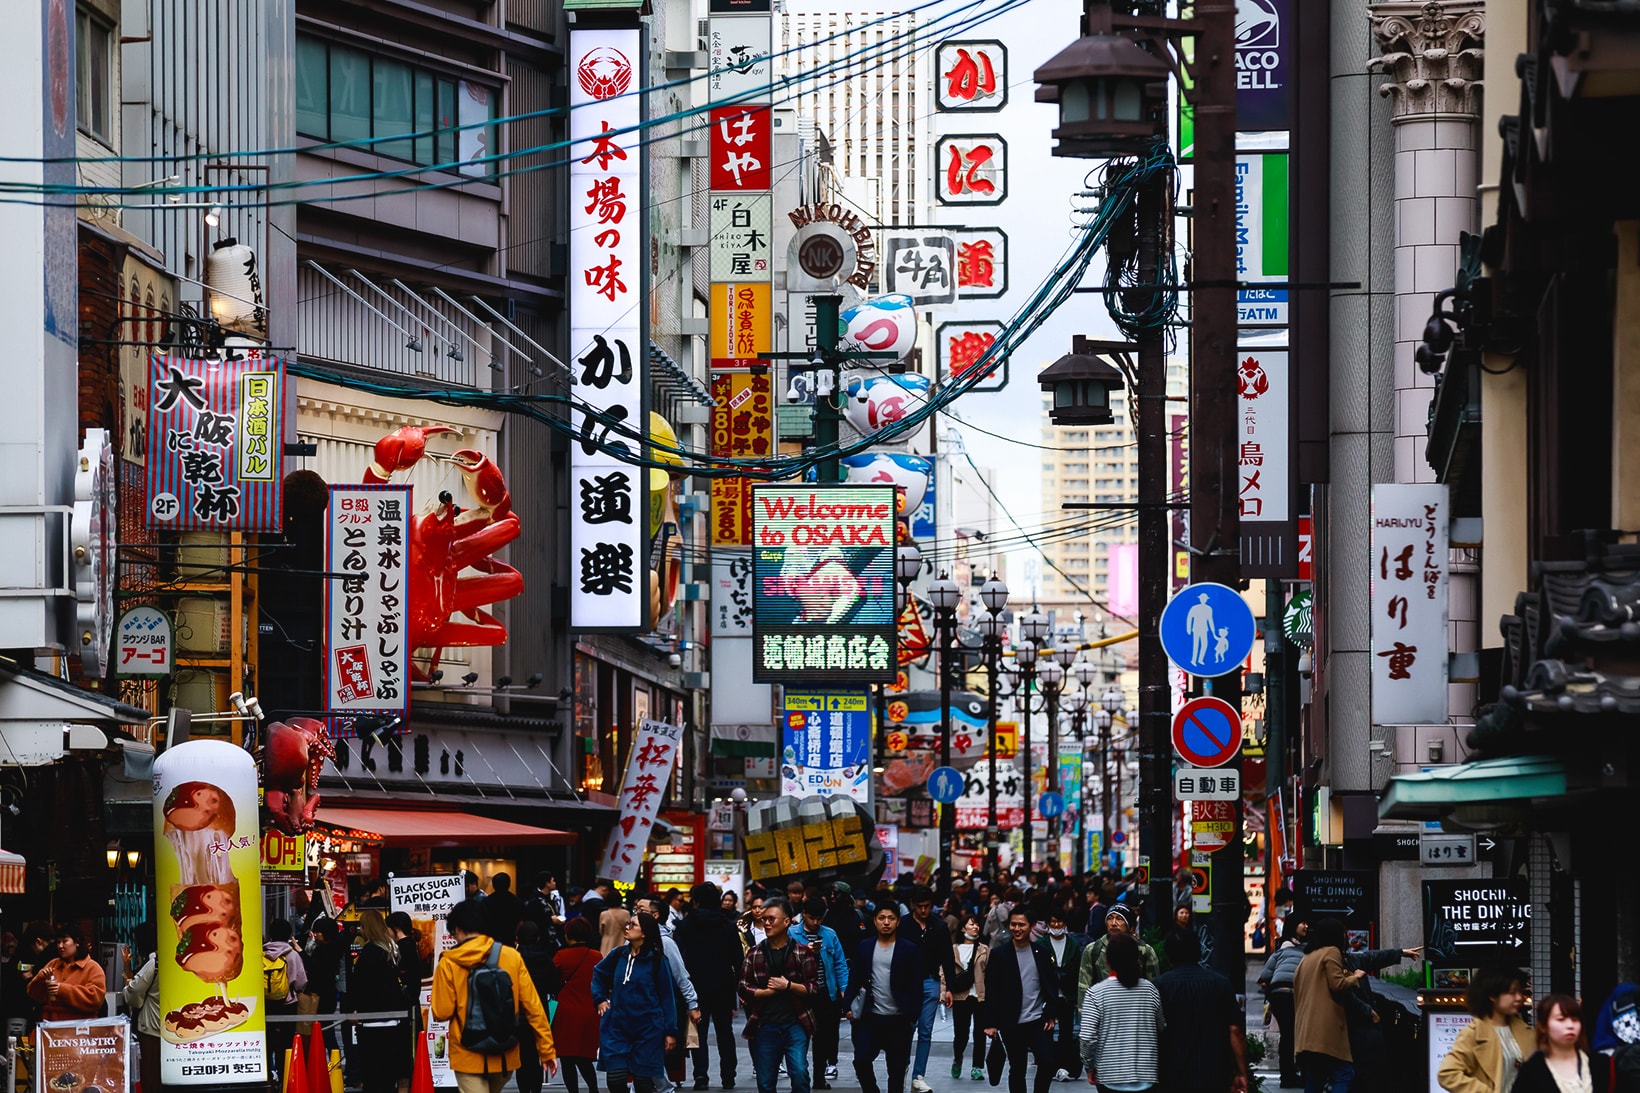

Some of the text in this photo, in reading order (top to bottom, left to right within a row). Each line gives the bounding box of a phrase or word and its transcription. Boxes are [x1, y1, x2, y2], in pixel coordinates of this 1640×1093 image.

[1234, 51, 1279, 70] ACO
[1236, 71, 1279, 90] ELL
[719, 110, 761, 185] はや
[581, 120, 628, 302] 本場の味
[713, 199, 728, 211] 4F
[788, 202, 858, 231] NIKOH
[730, 202, 767, 275] 白木屋
[809, 247, 833, 267] NK
[246, 378, 268, 474] 日本酒バル
[1245, 407, 1257, 434] 三代目
[155, 365, 240, 522] 大阪に乾杯
[155, 499, 177, 515] 2F
[341, 498, 368, 512] B級
[759, 493, 889, 520] Welcome
[338, 513, 372, 524] グルメ
[1376, 518, 1423, 528] HARIJYU
[760, 524, 890, 546] to OSAKA
[376, 500, 402, 701] 温泉水しゃぶしゃぶ
[1376, 544, 1418, 680] はり重
[122, 635, 165, 644] ラウンジ BAR
[122, 647, 166, 664] アーゴ
[787, 697, 807, 705] 340m
[808, 775, 842, 787] EDION
[1179, 777, 1237, 794] 自動車
[394, 877, 461, 895] BLACK SUGAR
[1313, 876, 1355, 885] SHOCHIKU
[396, 889, 450, 905] TAPIOCA
[1305, 886, 1363, 896] THE DINING
[1441, 905, 1471, 919] THE
[79, 1036, 118, 1046] PASTRY
[182, 1062, 262, 1076] 타코야키 핫도그
